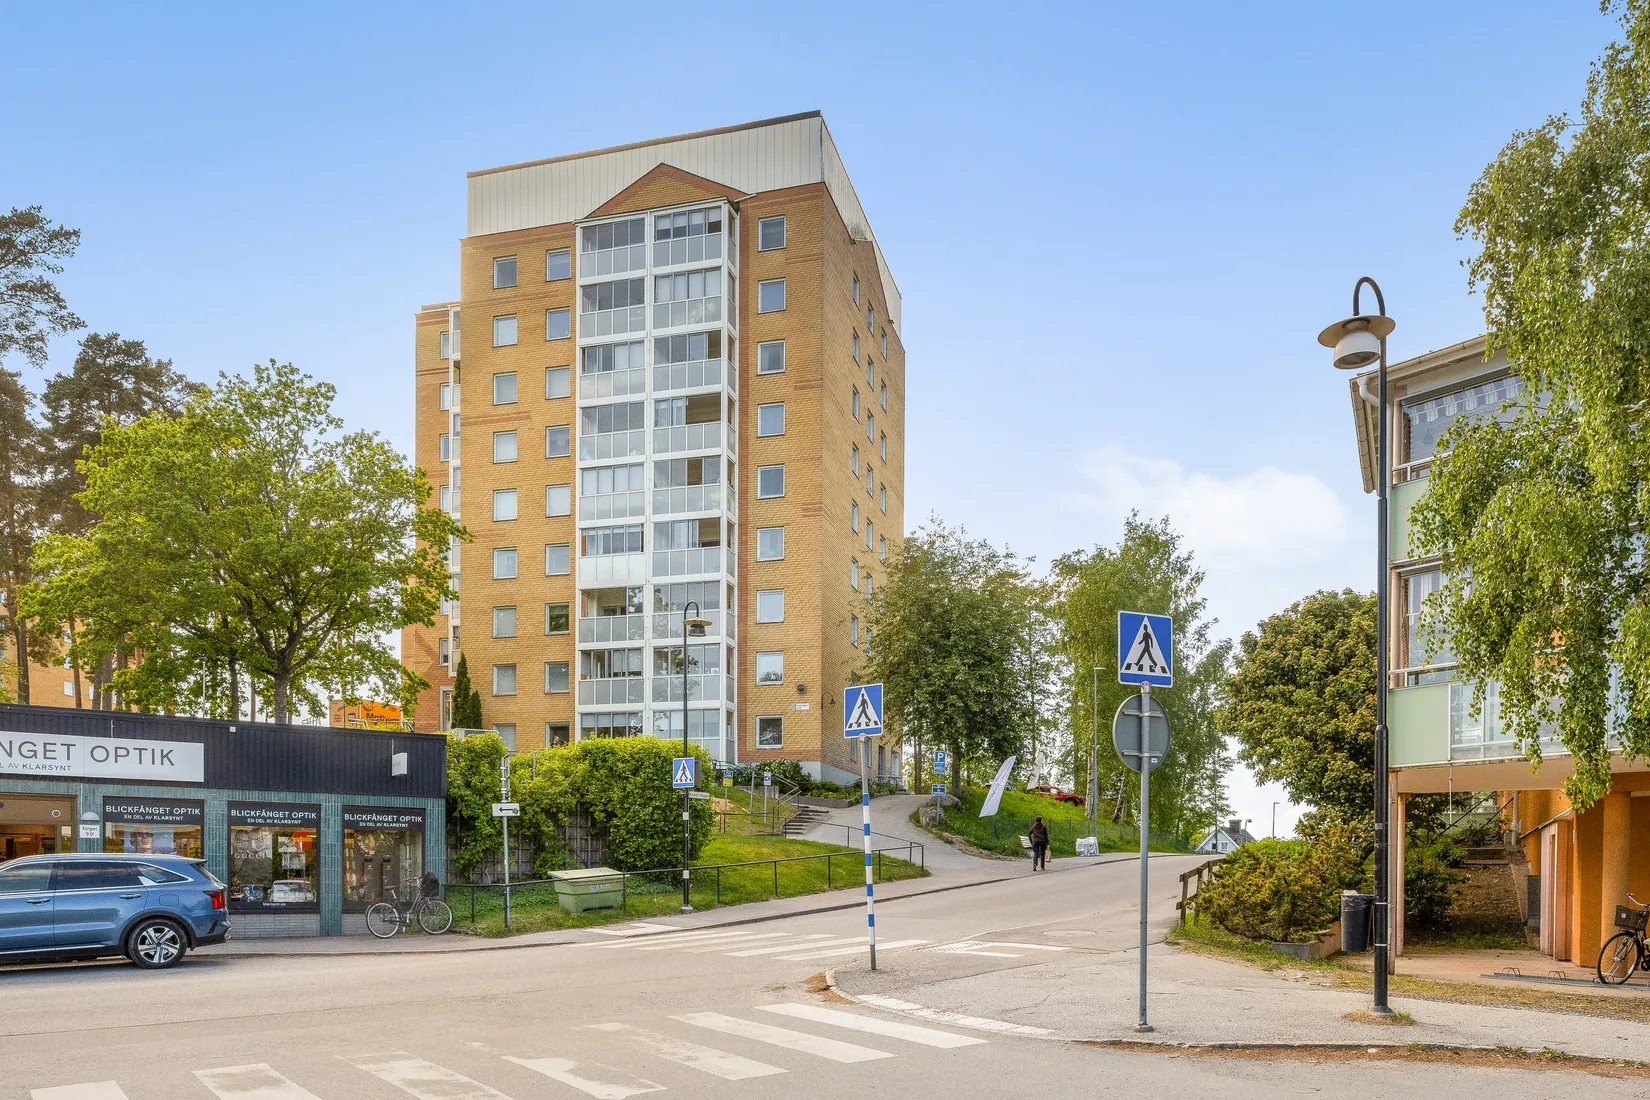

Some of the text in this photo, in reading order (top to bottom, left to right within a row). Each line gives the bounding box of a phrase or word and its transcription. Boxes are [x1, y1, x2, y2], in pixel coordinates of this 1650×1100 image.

[90, 745, 175, 766] OPTIK
[938, 752, 944, 761] P
[22, 763, 72, 772] KLARSYNT
[105, 804, 201, 815] BLICKFÅNGET OPTIK
[231, 809, 317, 819] BLICKFÅNGET OPTIK
[344, 813, 423, 823] BLICKFÅNGET OPTIK
